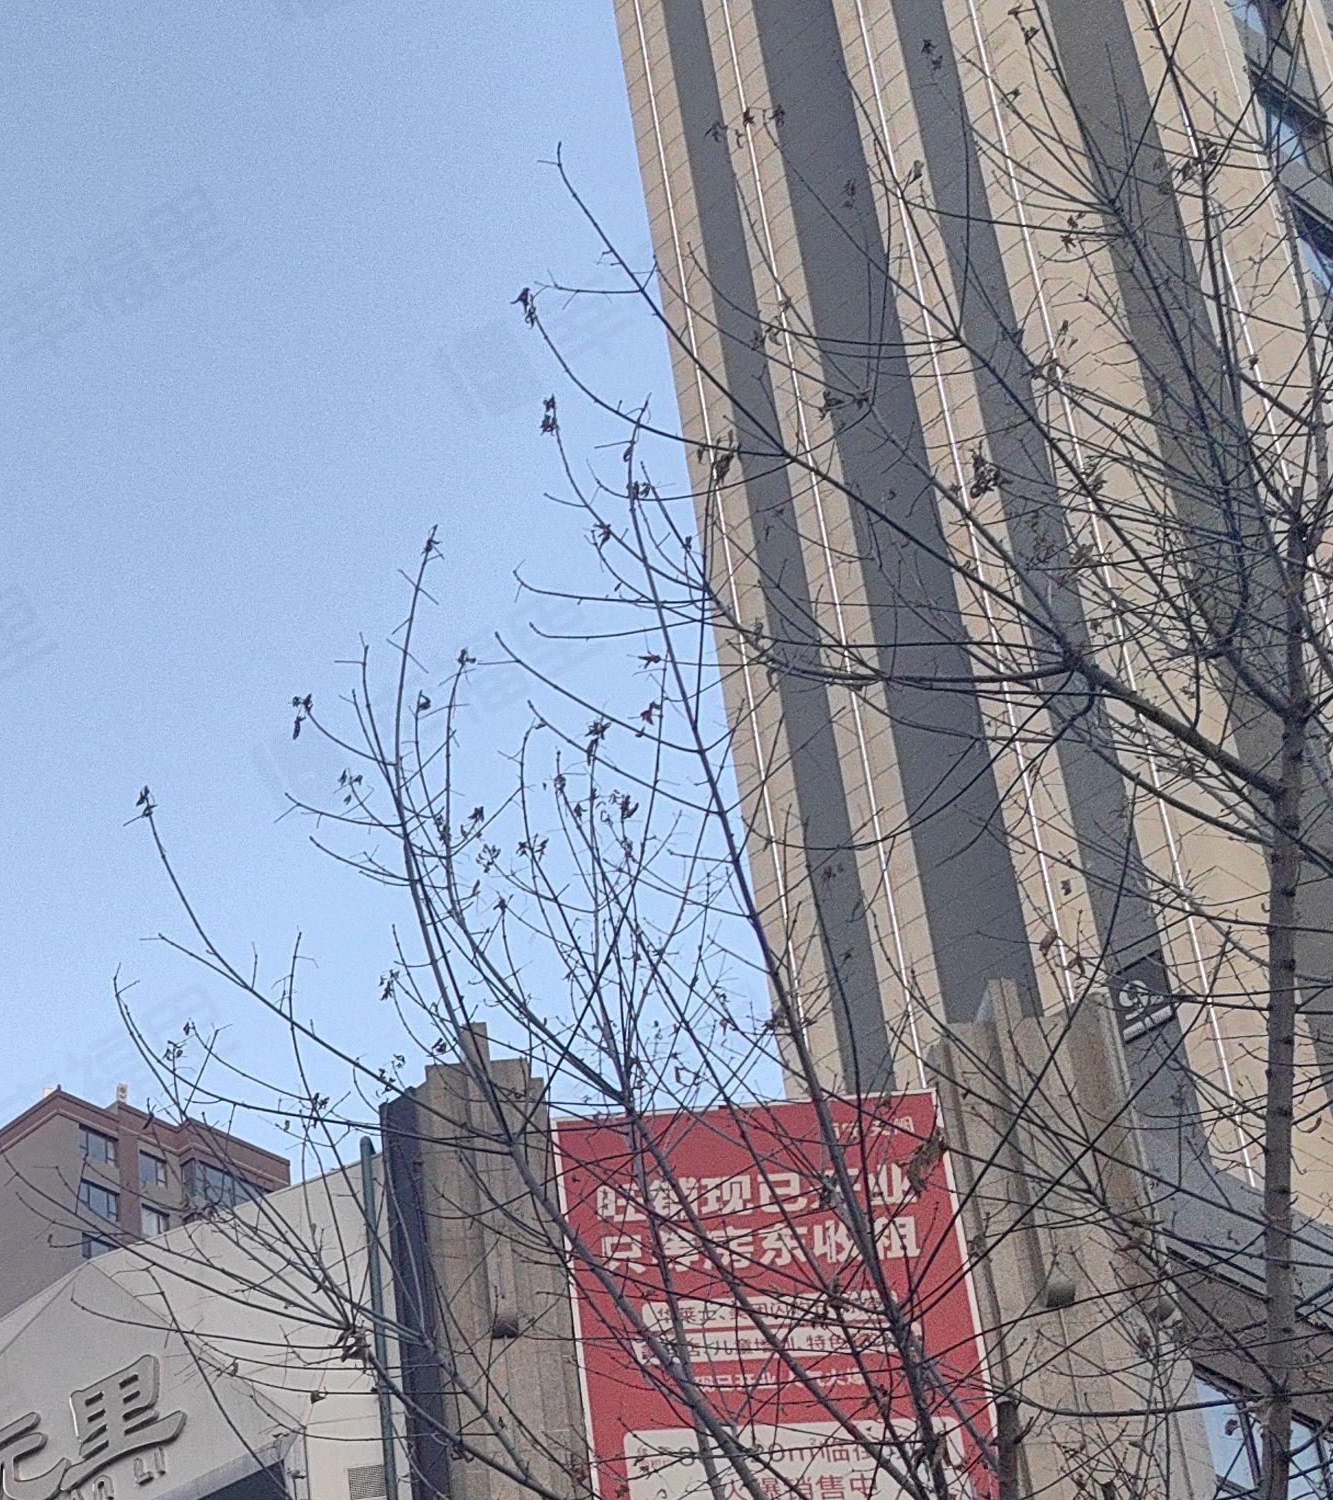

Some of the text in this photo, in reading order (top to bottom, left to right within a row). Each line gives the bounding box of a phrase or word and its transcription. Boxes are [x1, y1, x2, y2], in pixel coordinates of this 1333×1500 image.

[601, 1215, 921, 1275] 只等房东收租
[133, 1446, 168, 1486] LI
